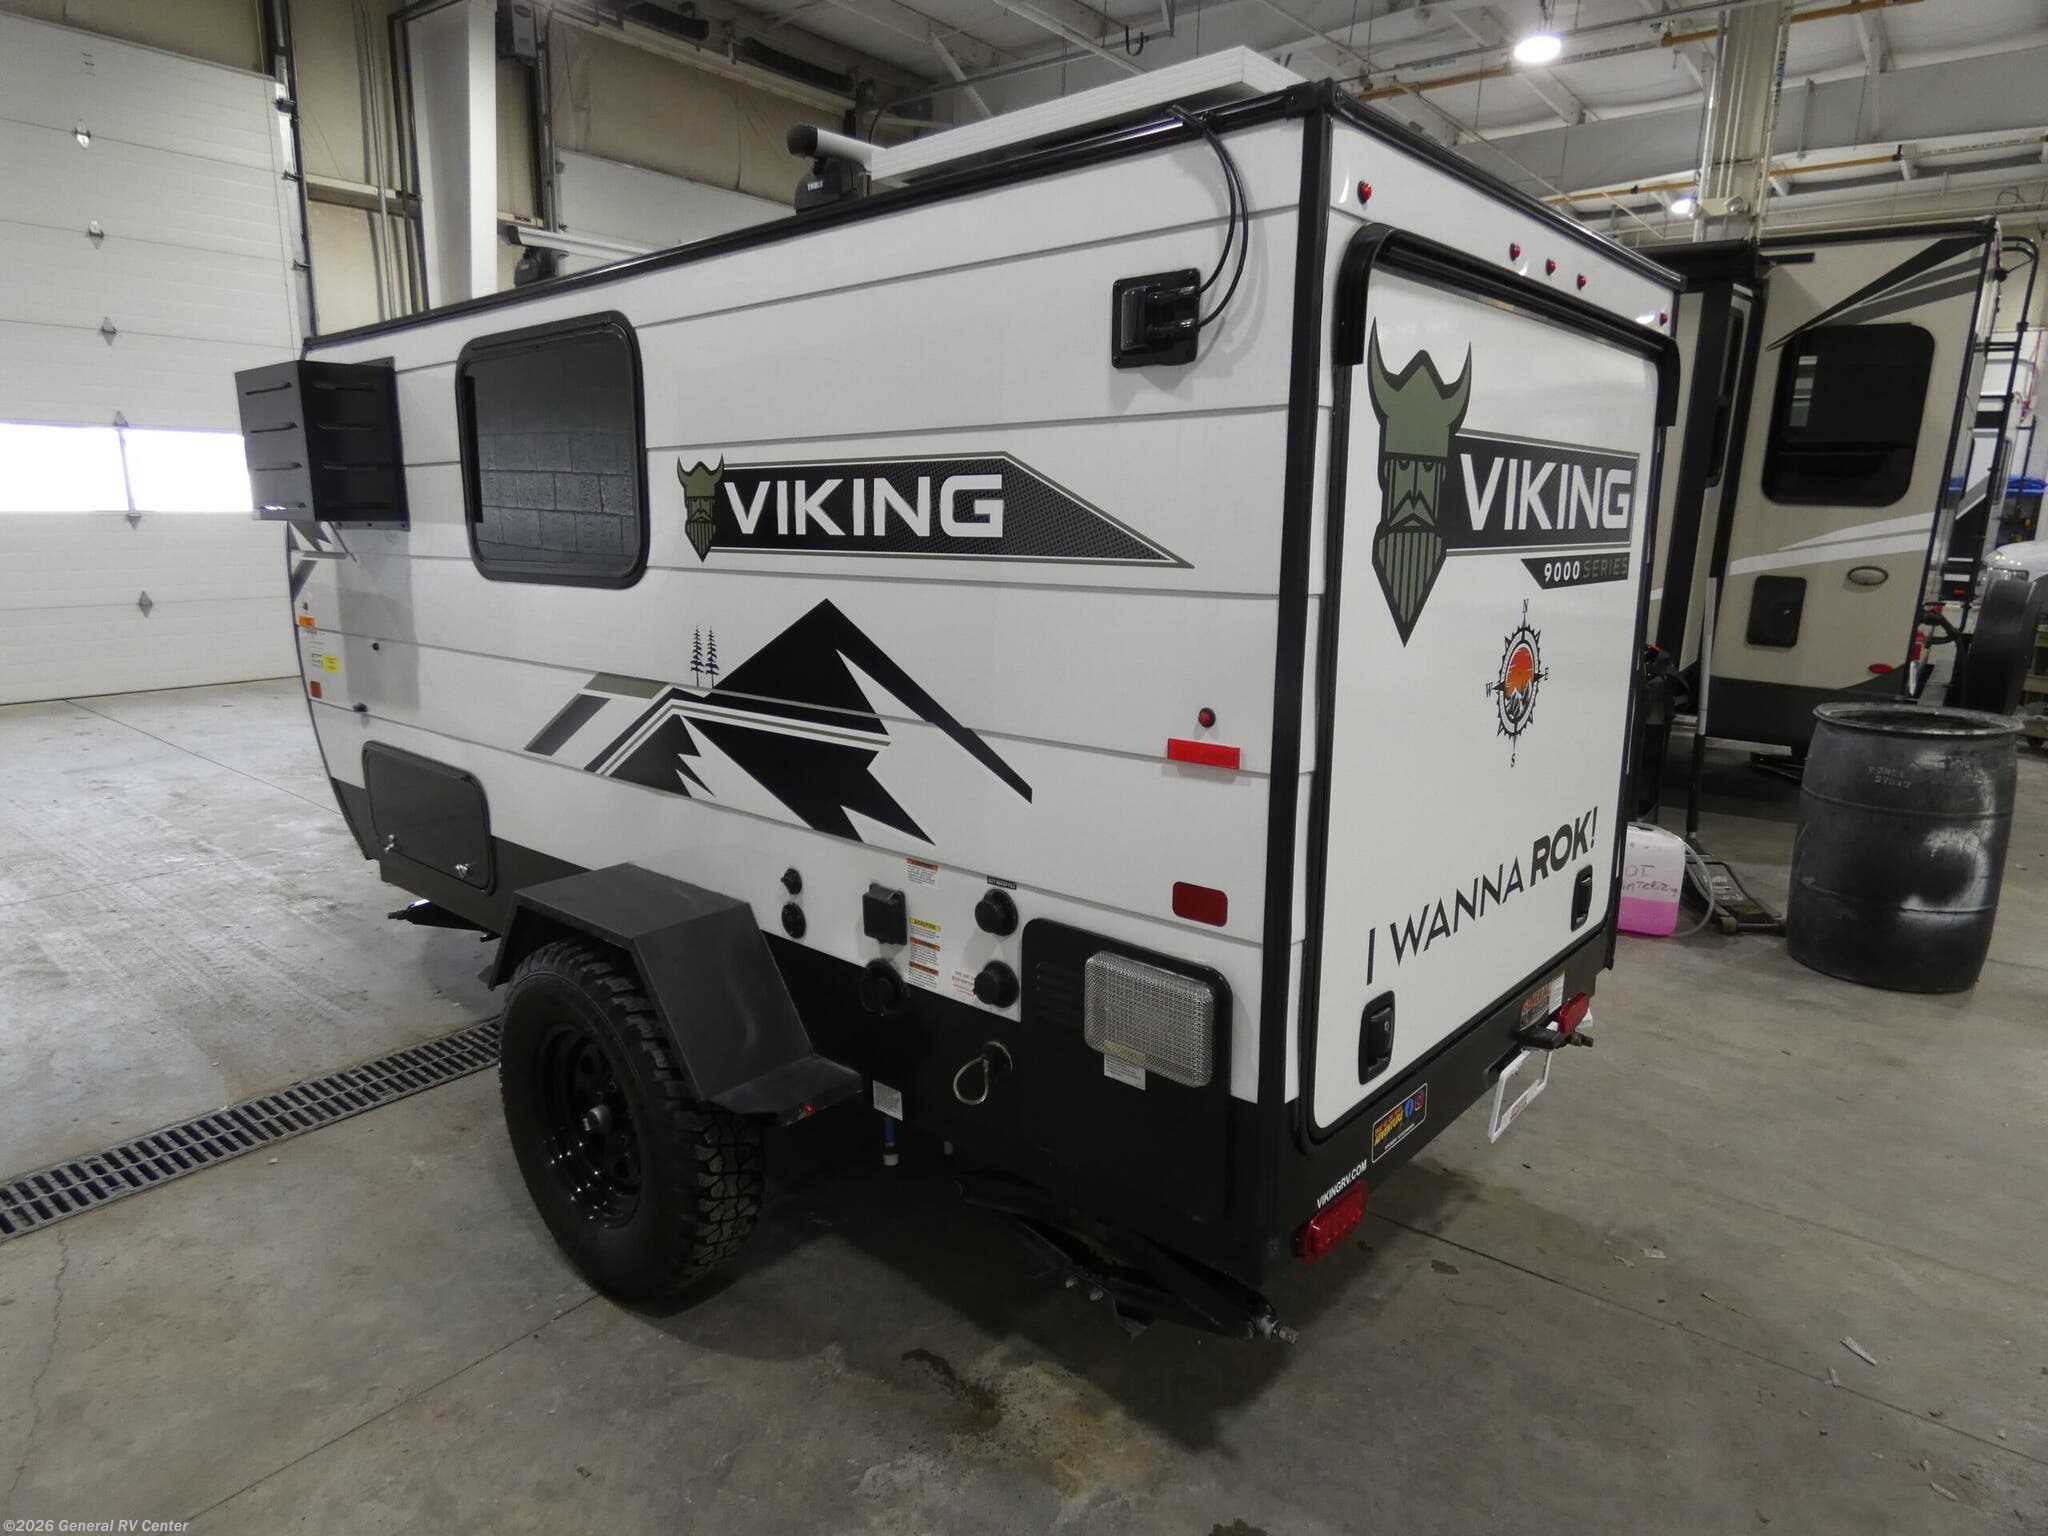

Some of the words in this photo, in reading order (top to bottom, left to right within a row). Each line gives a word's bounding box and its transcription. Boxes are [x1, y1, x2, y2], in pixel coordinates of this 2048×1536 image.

[1460, 453, 1632, 531] VIKING
[723, 474, 1004, 538] VIKING
[1544, 560, 1580, 583] 9000
[1582, 557, 1629, 580] SERIES
[1522, 598, 1530, 614] N
[1544, 667, 1549, 681] E
[1485, 681, 1493, 699] W
[1510, 752, 1516, 769] S
[1366, 927, 1376, 986] I
[1389, 855, 1525, 967] WANNA
[1530, 805, 1598, 888] ROK!
[1316, 1159, 1368, 1209] VIKINGRV.COM
